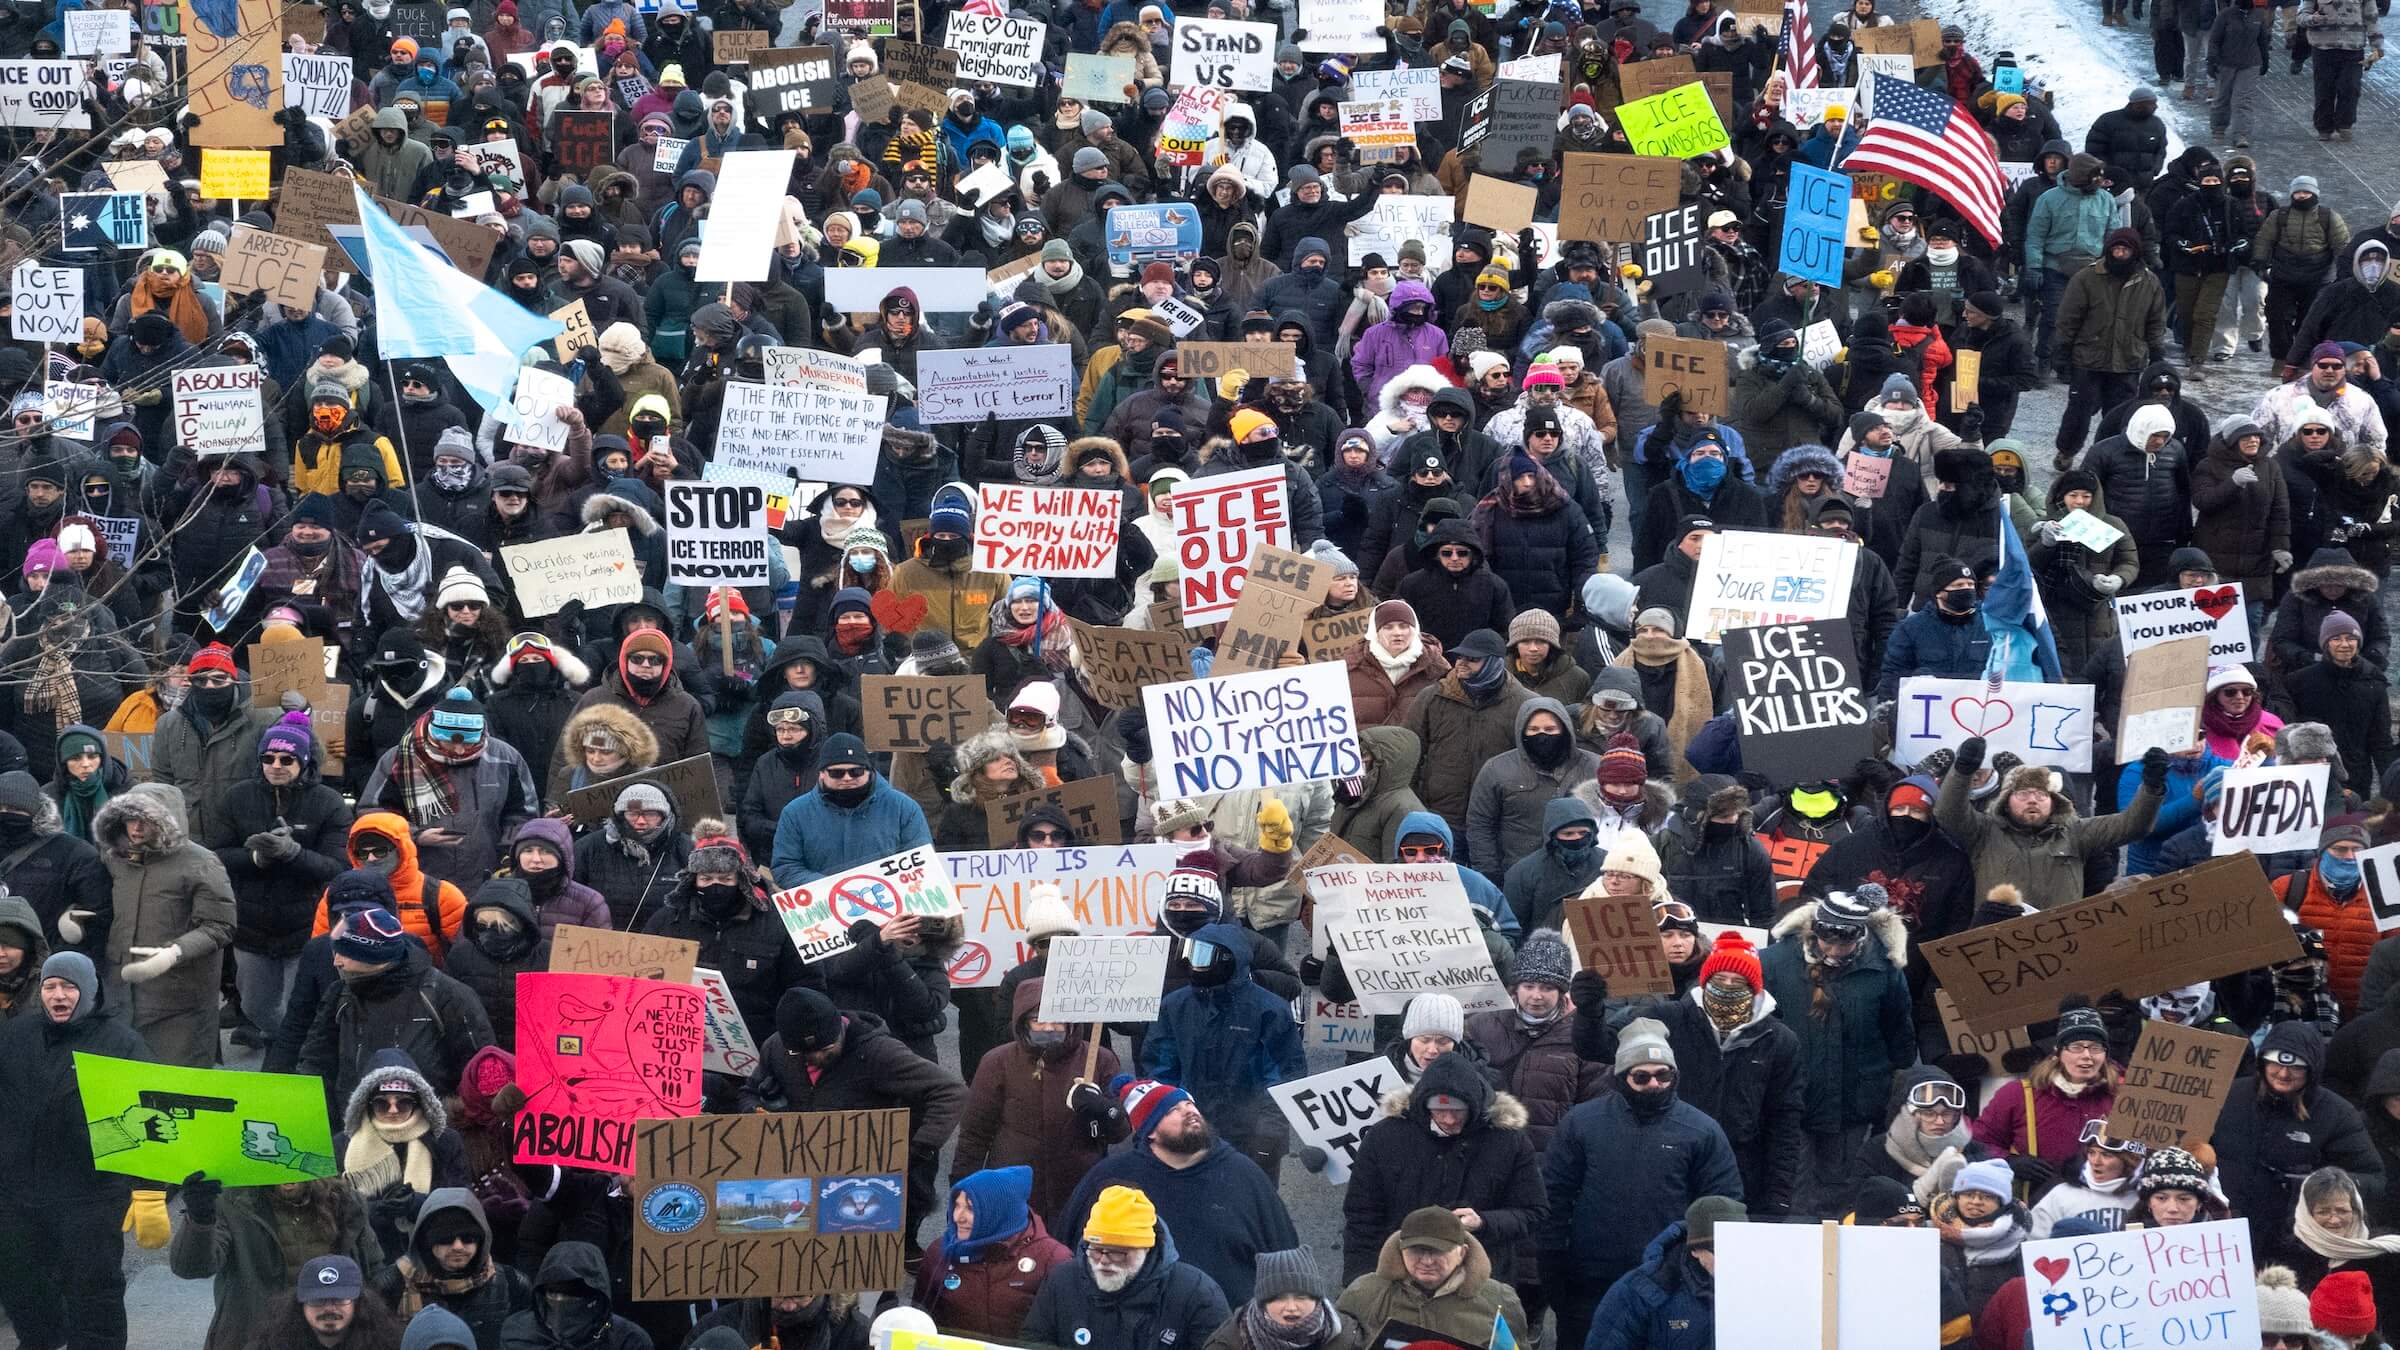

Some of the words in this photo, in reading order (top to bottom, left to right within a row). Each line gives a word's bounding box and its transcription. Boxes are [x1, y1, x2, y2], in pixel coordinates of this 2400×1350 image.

[397, 8, 426, 20] FUCK
[827, 18, 893, 27] LEAVENWORTH
[397, 22, 437, 38] ICE!
[951, 14, 977, 34] We
[1004, 20, 1037, 41] Our
[719, 33, 753, 47] FUCK
[948, 33, 1031, 64] Immigrant
[903, 43, 938, 59] STOP
[1202, 54, 1241, 65] WITH
[1, 67, 28, 84] ICE
[38, 67, 72, 85] OUT
[752, 60, 831, 91] ABOLISH
[909, 64, 930, 76] OUR
[1195, 64, 1236, 88] US
[1355, 72, 1383, 88] ICE
[1390, 67, 1440, 85] AGENTS
[4, 96, 22, 108] For
[781, 89, 812, 112] ICE
[1379, 88, 1408, 99] ARE
[1537, 86, 1560, 100] ICE
[1791, 93, 1811, 105] NO
[1342, 103, 1384, 113] TRUMP
[1470, 94, 1490, 118] ICE
[1644, 93, 1696, 128] ICE
[1341, 121, 1408, 136] DOMESTIC
[1349, 113, 1381, 123] ICE
[1168, 140, 1206, 151] OUT
[1350, 133, 1416, 145] ERRORISTS
[1579, 163, 1665, 188] ICE
[112, 196, 142, 219] ICE
[1580, 192, 1616, 209] OUT
[1626, 197, 1657, 211] OF
[1801, 175, 1845, 220] ICE
[1113, 212, 1127, 223] NO
[1129, 212, 1160, 224] HUMAN
[1413, 203, 1438, 222] WE
[112, 221, 142, 244] OUT
[1125, 222, 1158, 233] ILLEGAL
[1647, 205, 1699, 248] ICE
[244, 234, 303, 259] ARREST
[1646, 238, 1699, 276] OUT
[1786, 227, 1842, 273] OUT
[20, 269, 70, 289] ICE
[238, 252, 307, 301] ICE
[15, 292, 75, 312] OUT
[1161, 300, 1178, 315] ICE
[1176, 305, 1199, 326] OUT
[20, 314, 79, 335] NOW
[963, 357, 977, 366] We
[1183, 349, 1218, 375] NO
[1807, 342, 1834, 361] OUT
[774, 365, 785, 380] &
[1655, 351, 1706, 375] ICE
[176, 371, 260, 392] ABOLISH
[931, 371, 1000, 385] Accountability
[47, 385, 98, 401] JUSTICE
[772, 391, 809, 409] PARTY
[840, 397, 857, 412] YOU
[863, 399, 874, 412] TO
[974, 390, 1001, 408] ICE
[727, 408, 766, 424] REJECT
[770, 410, 785, 424] THE
[793, 411, 841, 427] EVIDENCE
[846, 416, 859, 427] OF
[722, 427, 745, 440] EYES
[752, 427, 773, 440] AND
[806, 430, 815, 442] IT
[819, 431, 839, 444] WAS
[843, 432, 868, 446] THEIR
[762, 446, 786, 458] MOST
[791, 447, 845, 461] ESSENTIAL
[671, 486, 763, 530] STOP
[982, 490, 1022, 512] WE
[1177, 485, 1282, 535] ICE
[671, 540, 698, 560] ICE
[699, 539, 765, 560] TERROR
[977, 540, 1113, 569] TYRANNY
[511, 553, 576, 574] Queridos
[671, 563, 768, 578] NOW!
[1252, 553, 1316, 592] ICE
[546, 566, 582, 585] Estoy
[539, 594, 563, 612] ICE
[607, 582, 637, 600] NOW
[1772, 577, 1826, 604] EYES
[2120, 603, 2138, 616] IN
[2141, 597, 2187, 612] YOUR
[2190, 593, 2240, 612] HEART
[1257, 610, 1282, 628] OF
[2132, 627, 2167, 640] YOU
[2170, 620, 2218, 637] KNOW
[1078, 627, 1184, 667] DEATH
[1742, 656, 1846, 696] PAID
[884, 685, 966, 710] FUCK
[1165, 686, 1204, 726] NO
[1737, 687, 1870, 736] KILLERS
[888, 710, 971, 747] ICE
[1172, 726, 1213, 758] NO
[1174, 753, 1244, 796] NO
[1259, 739, 1361, 784] NAZIS
[2222, 778, 2322, 839] UFFDA
[880, 851, 926, 877] ICE
[947, 851, 1039, 879] TRUMP
[1055, 848, 1089, 872] IS
[1117, 848, 1137, 869] A
[900, 868, 924, 885] OUT
[1366, 870, 1382, 884] IS
[1386, 871, 1399, 884] A
[1403, 869, 1450, 884] MORAL
[775, 888, 814, 913] NO
[2150, 882, 2190, 910] IS
[1356, 908, 1372, 925] IT
[1375, 908, 1392, 923] IS
[1398, 905, 1430, 923] NOT
[1581, 902, 1650, 940] ICE
[804, 926, 830, 944] IS
[1341, 929, 1388, 953] LEFT
[1392, 934, 1411, 948] OR
[1410, 926, 1473, 948] RIGHT
[1058, 939, 1101, 957] NOT
[1109, 939, 1165, 957] EVEN
[1392, 952, 1408, 966] IT
[1410, 950, 1431, 964] IS
[1059, 960, 1138, 979] HEATED
[1056, 980, 1128, 996] RIVALRY
[1356, 968, 1422, 993] RIGHT
[1425, 974, 1441, 988] OR
[1051, 997, 1100, 1014] HELPS
[1104, 996, 1161, 1015] ANYMORE
[646, 1008, 696, 1026] NEVER
[633, 1021, 648, 1034] A
[653, 1022, 702, 1041] CRIME
[652, 1036, 698, 1053] JUST
[2145, 1035, 2175, 1064] NO
[2185, 1040, 2222, 1072] ONE
[658, 1050, 681, 1066] TO
[643, 1063, 696, 1084] EXIST
[2131, 1065, 2153, 1087] IS
[2157, 1072, 2216, 1101] ILLEGAL
[1292, 1073, 1386, 1132] FUCK
[2119, 1096, 2139, 1119] ON
[2142, 1098, 2188, 1125] STOLEN
[513, 1111, 636, 1170] ABOLISH
[641, 1118, 743, 1178] THIS
[754, 1110, 905, 1175] MACHINE
[639, 1239, 761, 1298] DEFEATS
[771, 1232, 906, 1297] TYRANNY
[2074, 1242, 2134, 1280] Be
[2082, 1283, 2141, 1317] Be
[2162, 1309, 2237, 1347] OUT
